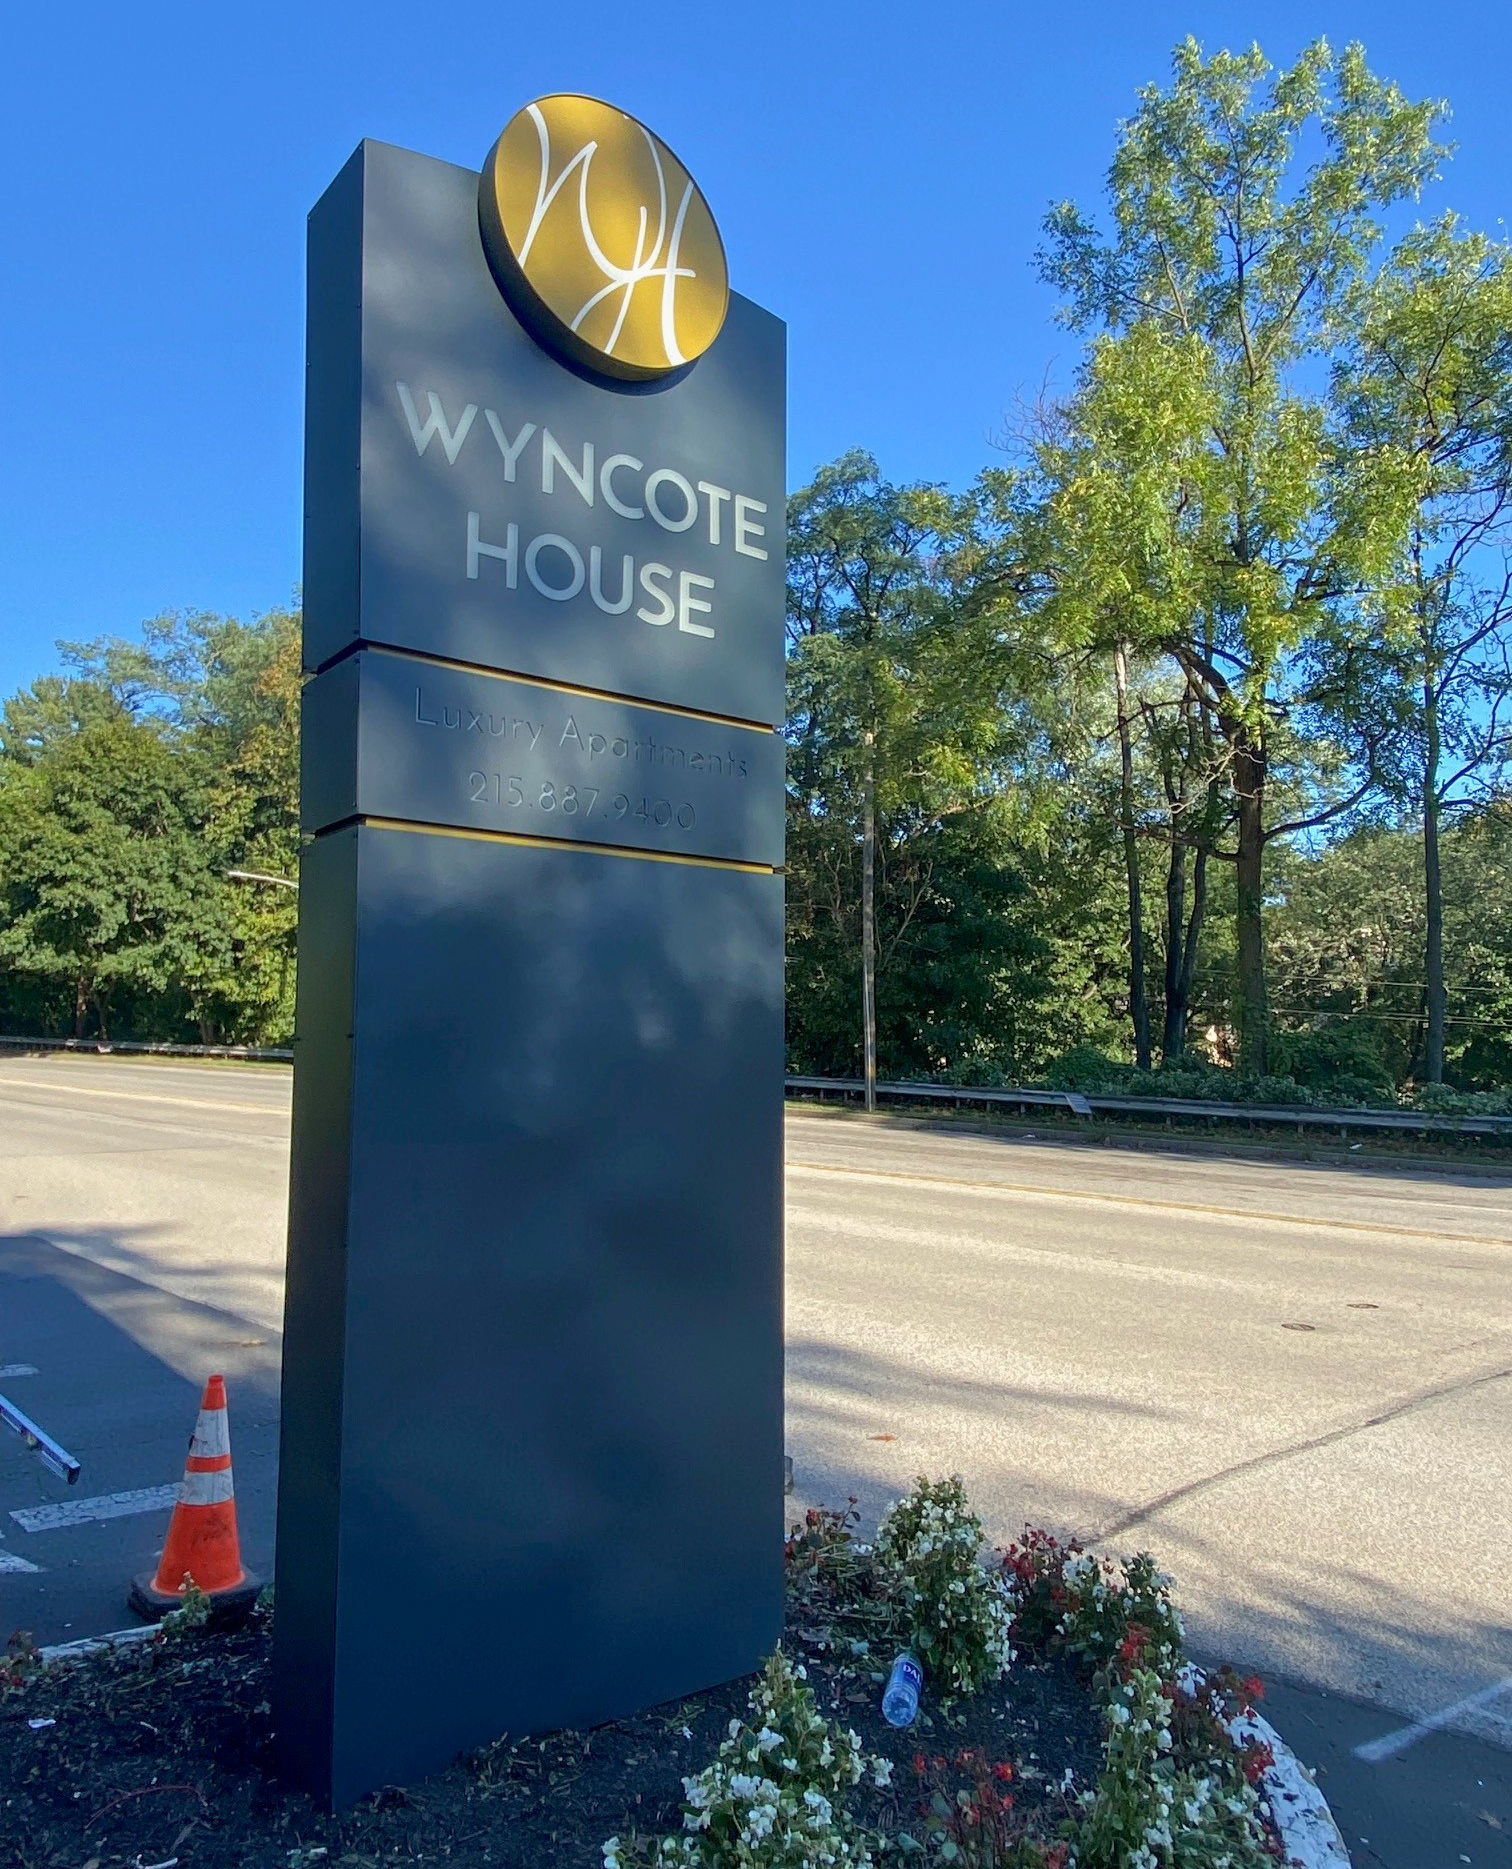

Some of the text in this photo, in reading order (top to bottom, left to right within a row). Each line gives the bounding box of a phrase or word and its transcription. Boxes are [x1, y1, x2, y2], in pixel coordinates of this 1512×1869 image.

[396, 381, 768, 561] WYNCOTE
[466, 511, 715, 638] HOUSE
[415, 686, 748, 780] Luxury Apartments
[469, 770, 698, 831] 215.887.9400
